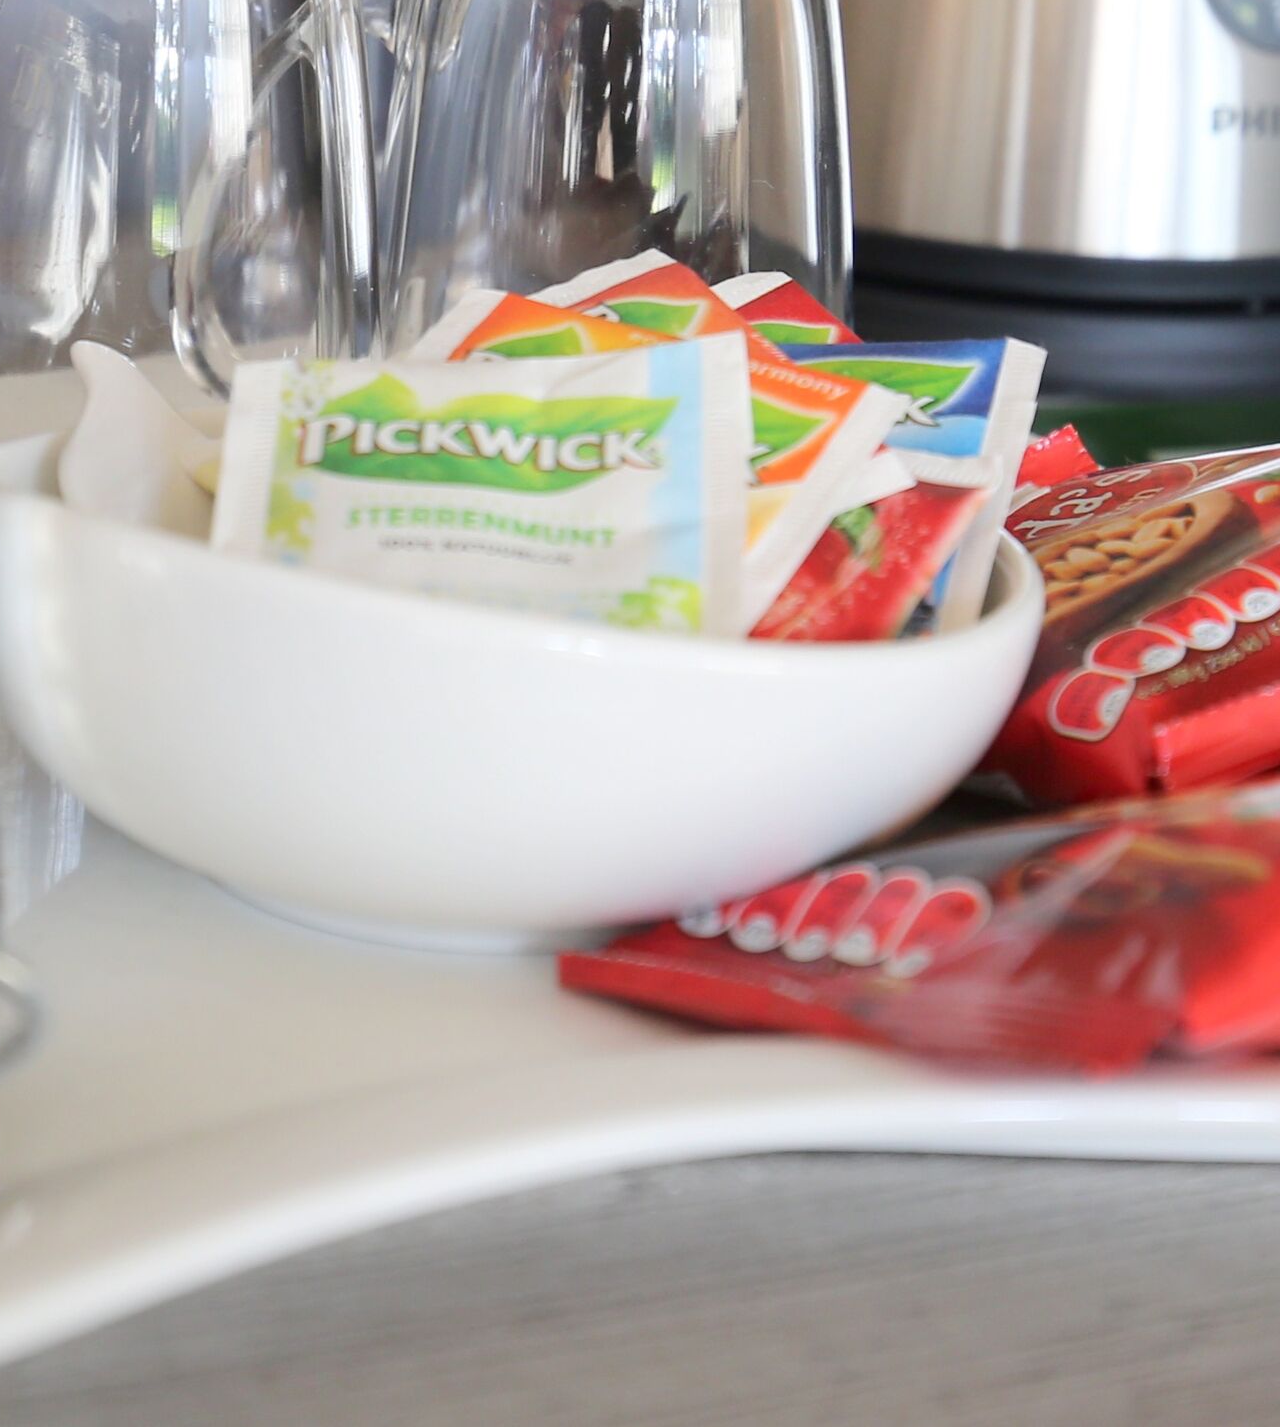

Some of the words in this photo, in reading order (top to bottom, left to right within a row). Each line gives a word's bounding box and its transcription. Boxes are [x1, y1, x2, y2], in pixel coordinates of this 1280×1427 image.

[750, 360, 850, 401] armony
[299, 411, 661, 471] PICKWICK
[347, 505, 617, 548] STERRENMUNT
